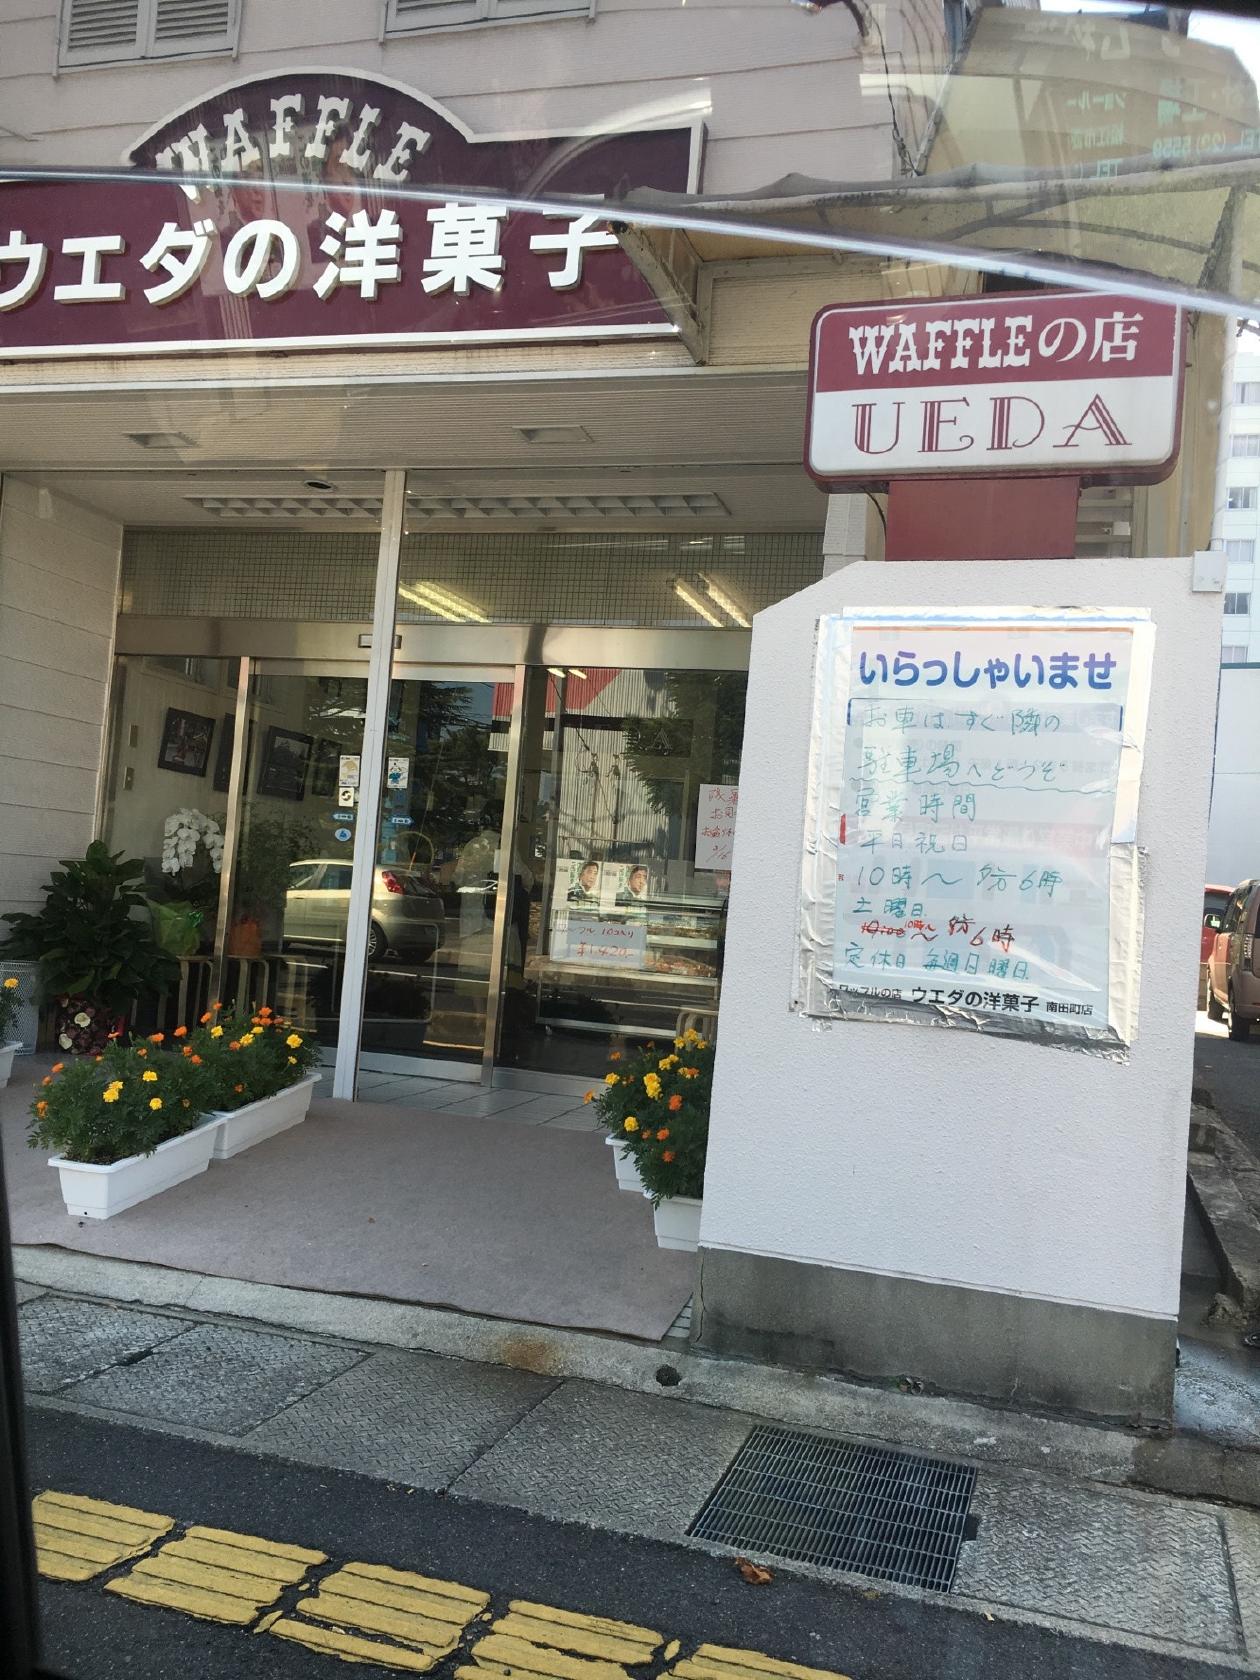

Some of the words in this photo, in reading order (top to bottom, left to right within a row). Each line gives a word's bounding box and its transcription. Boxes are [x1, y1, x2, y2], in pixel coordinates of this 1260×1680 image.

[155, 94, 432, 203] WAFFLE
[0, 194, 619, 312] ウエダの洋菓子
[848, 311, 1144, 375] WAFFLEの店
[851, 393, 1133, 454] UEDA
[859, 650, 1117, 690] いらっしゃいませ
[855, 787, 977, 823] 営業時間
[860, 829, 968, 855] 平日祝日
[911, 986, 1040, 1013] ウエダの洋菓子
[1046, 1000, 1093, 1016] 南田町店
